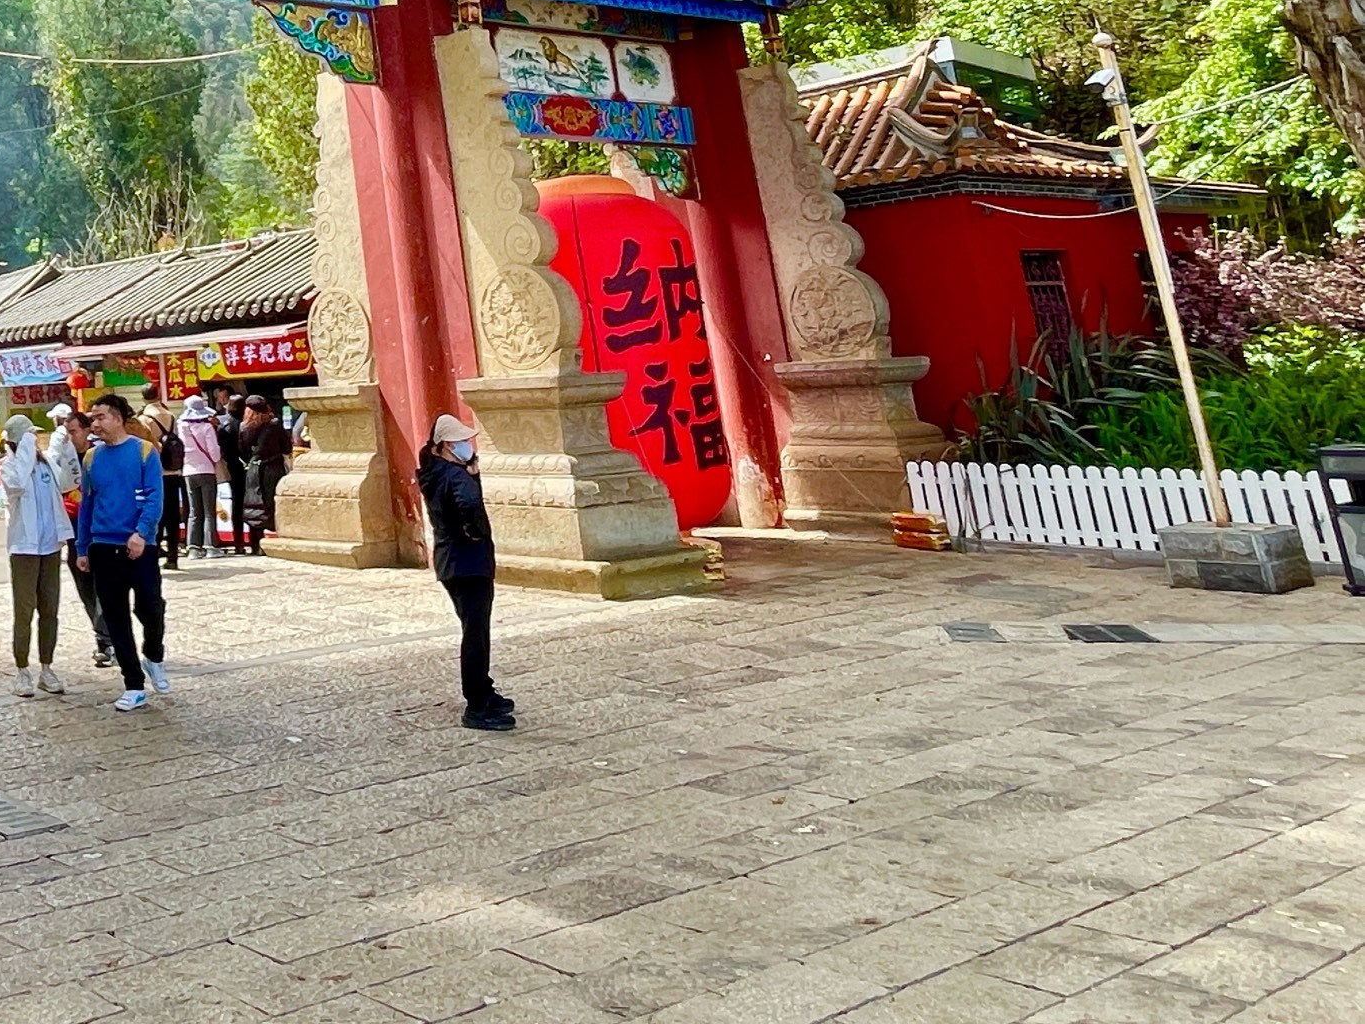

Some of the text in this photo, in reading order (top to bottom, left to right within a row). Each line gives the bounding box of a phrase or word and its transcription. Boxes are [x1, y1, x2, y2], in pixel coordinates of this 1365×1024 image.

[167, 353, 184, 399] 木瓜水
[225, 341, 294, 367] 洋芋粑粑
[602, 238, 730, 472] 纳福
